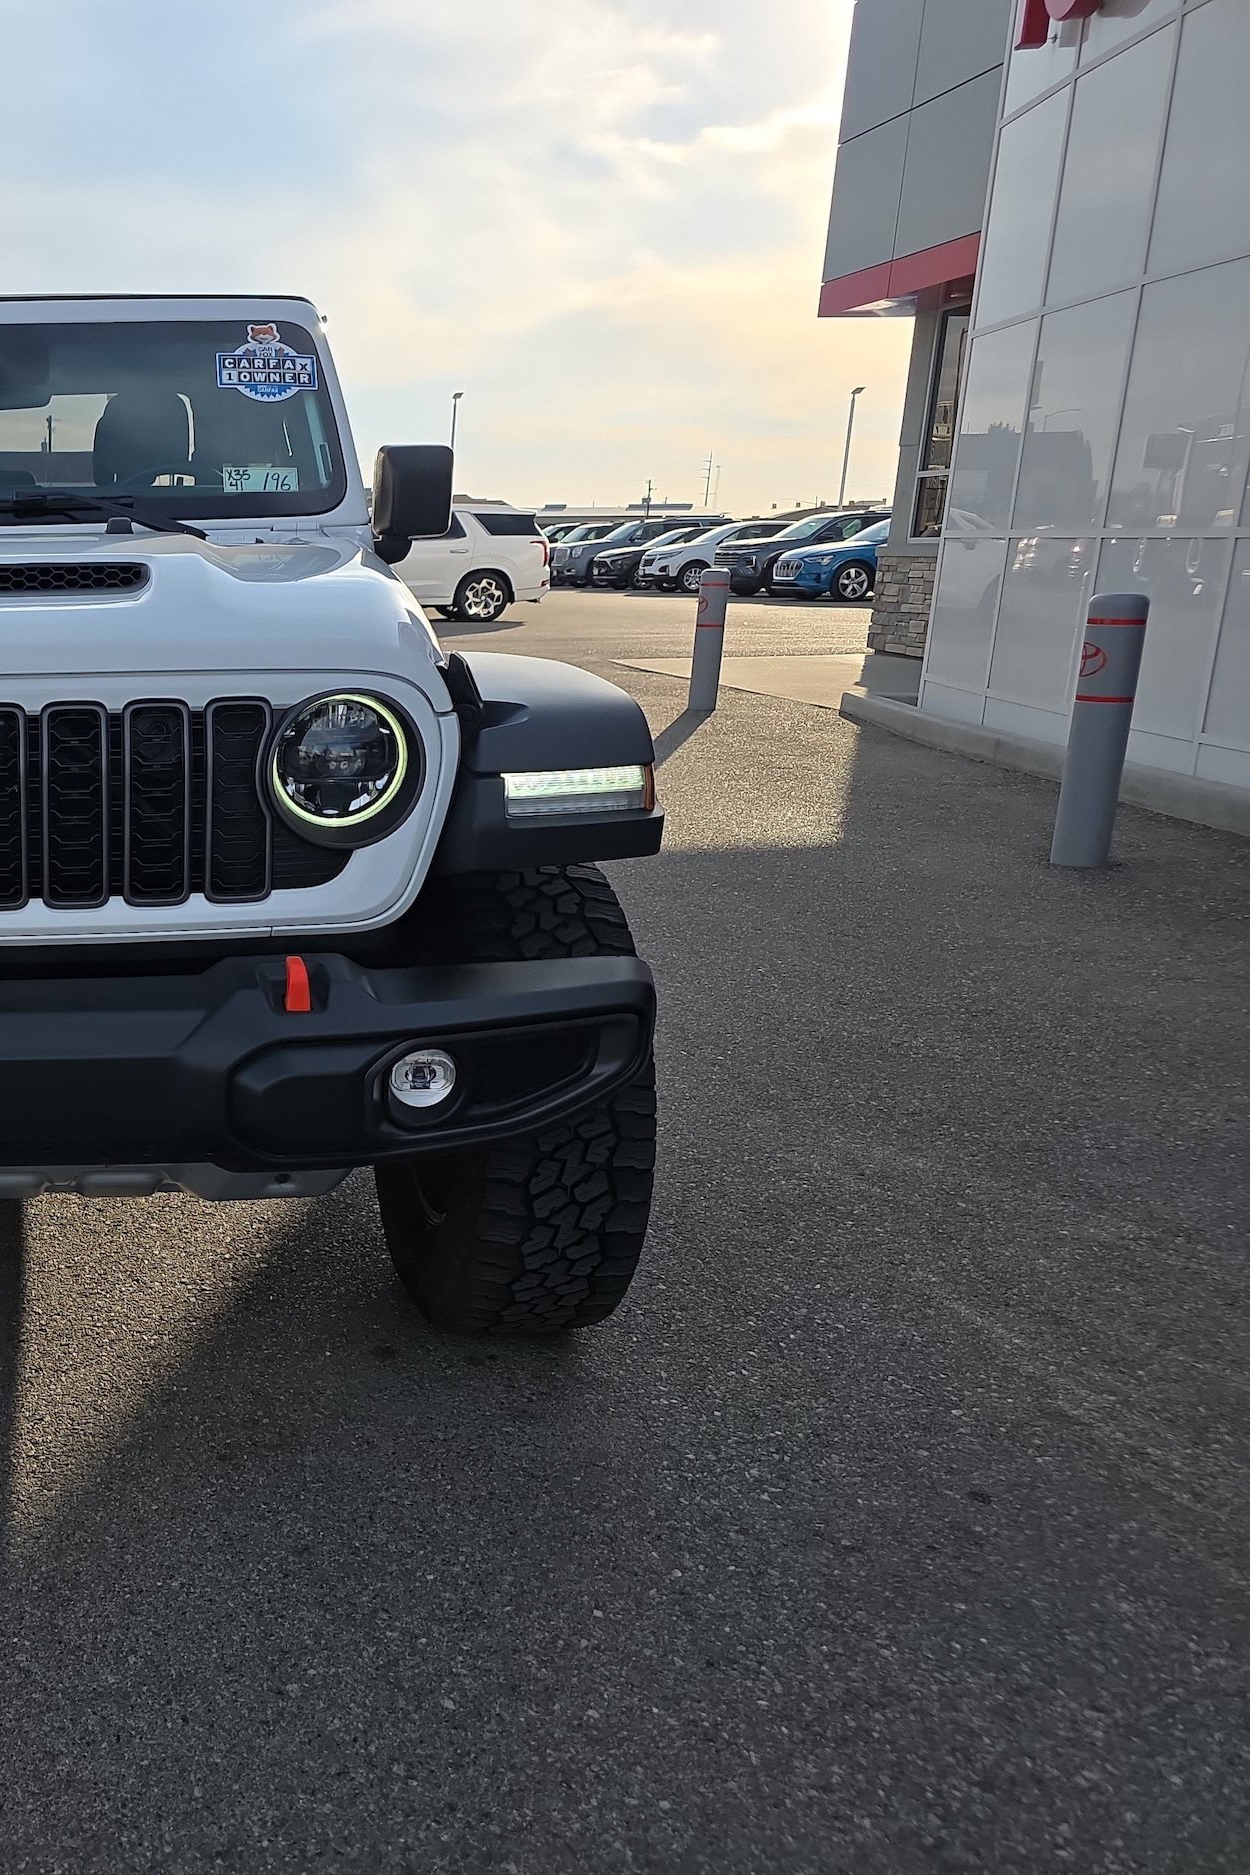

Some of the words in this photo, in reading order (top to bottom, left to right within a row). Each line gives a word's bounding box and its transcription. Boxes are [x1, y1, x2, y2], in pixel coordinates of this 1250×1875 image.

[224, 358, 308, 371] CARFAX
[225, 372, 236, 381] 1
[240, 372, 310, 384] OWNER
[230, 480, 244, 491] 41
[263, 472, 291, 491] 196
